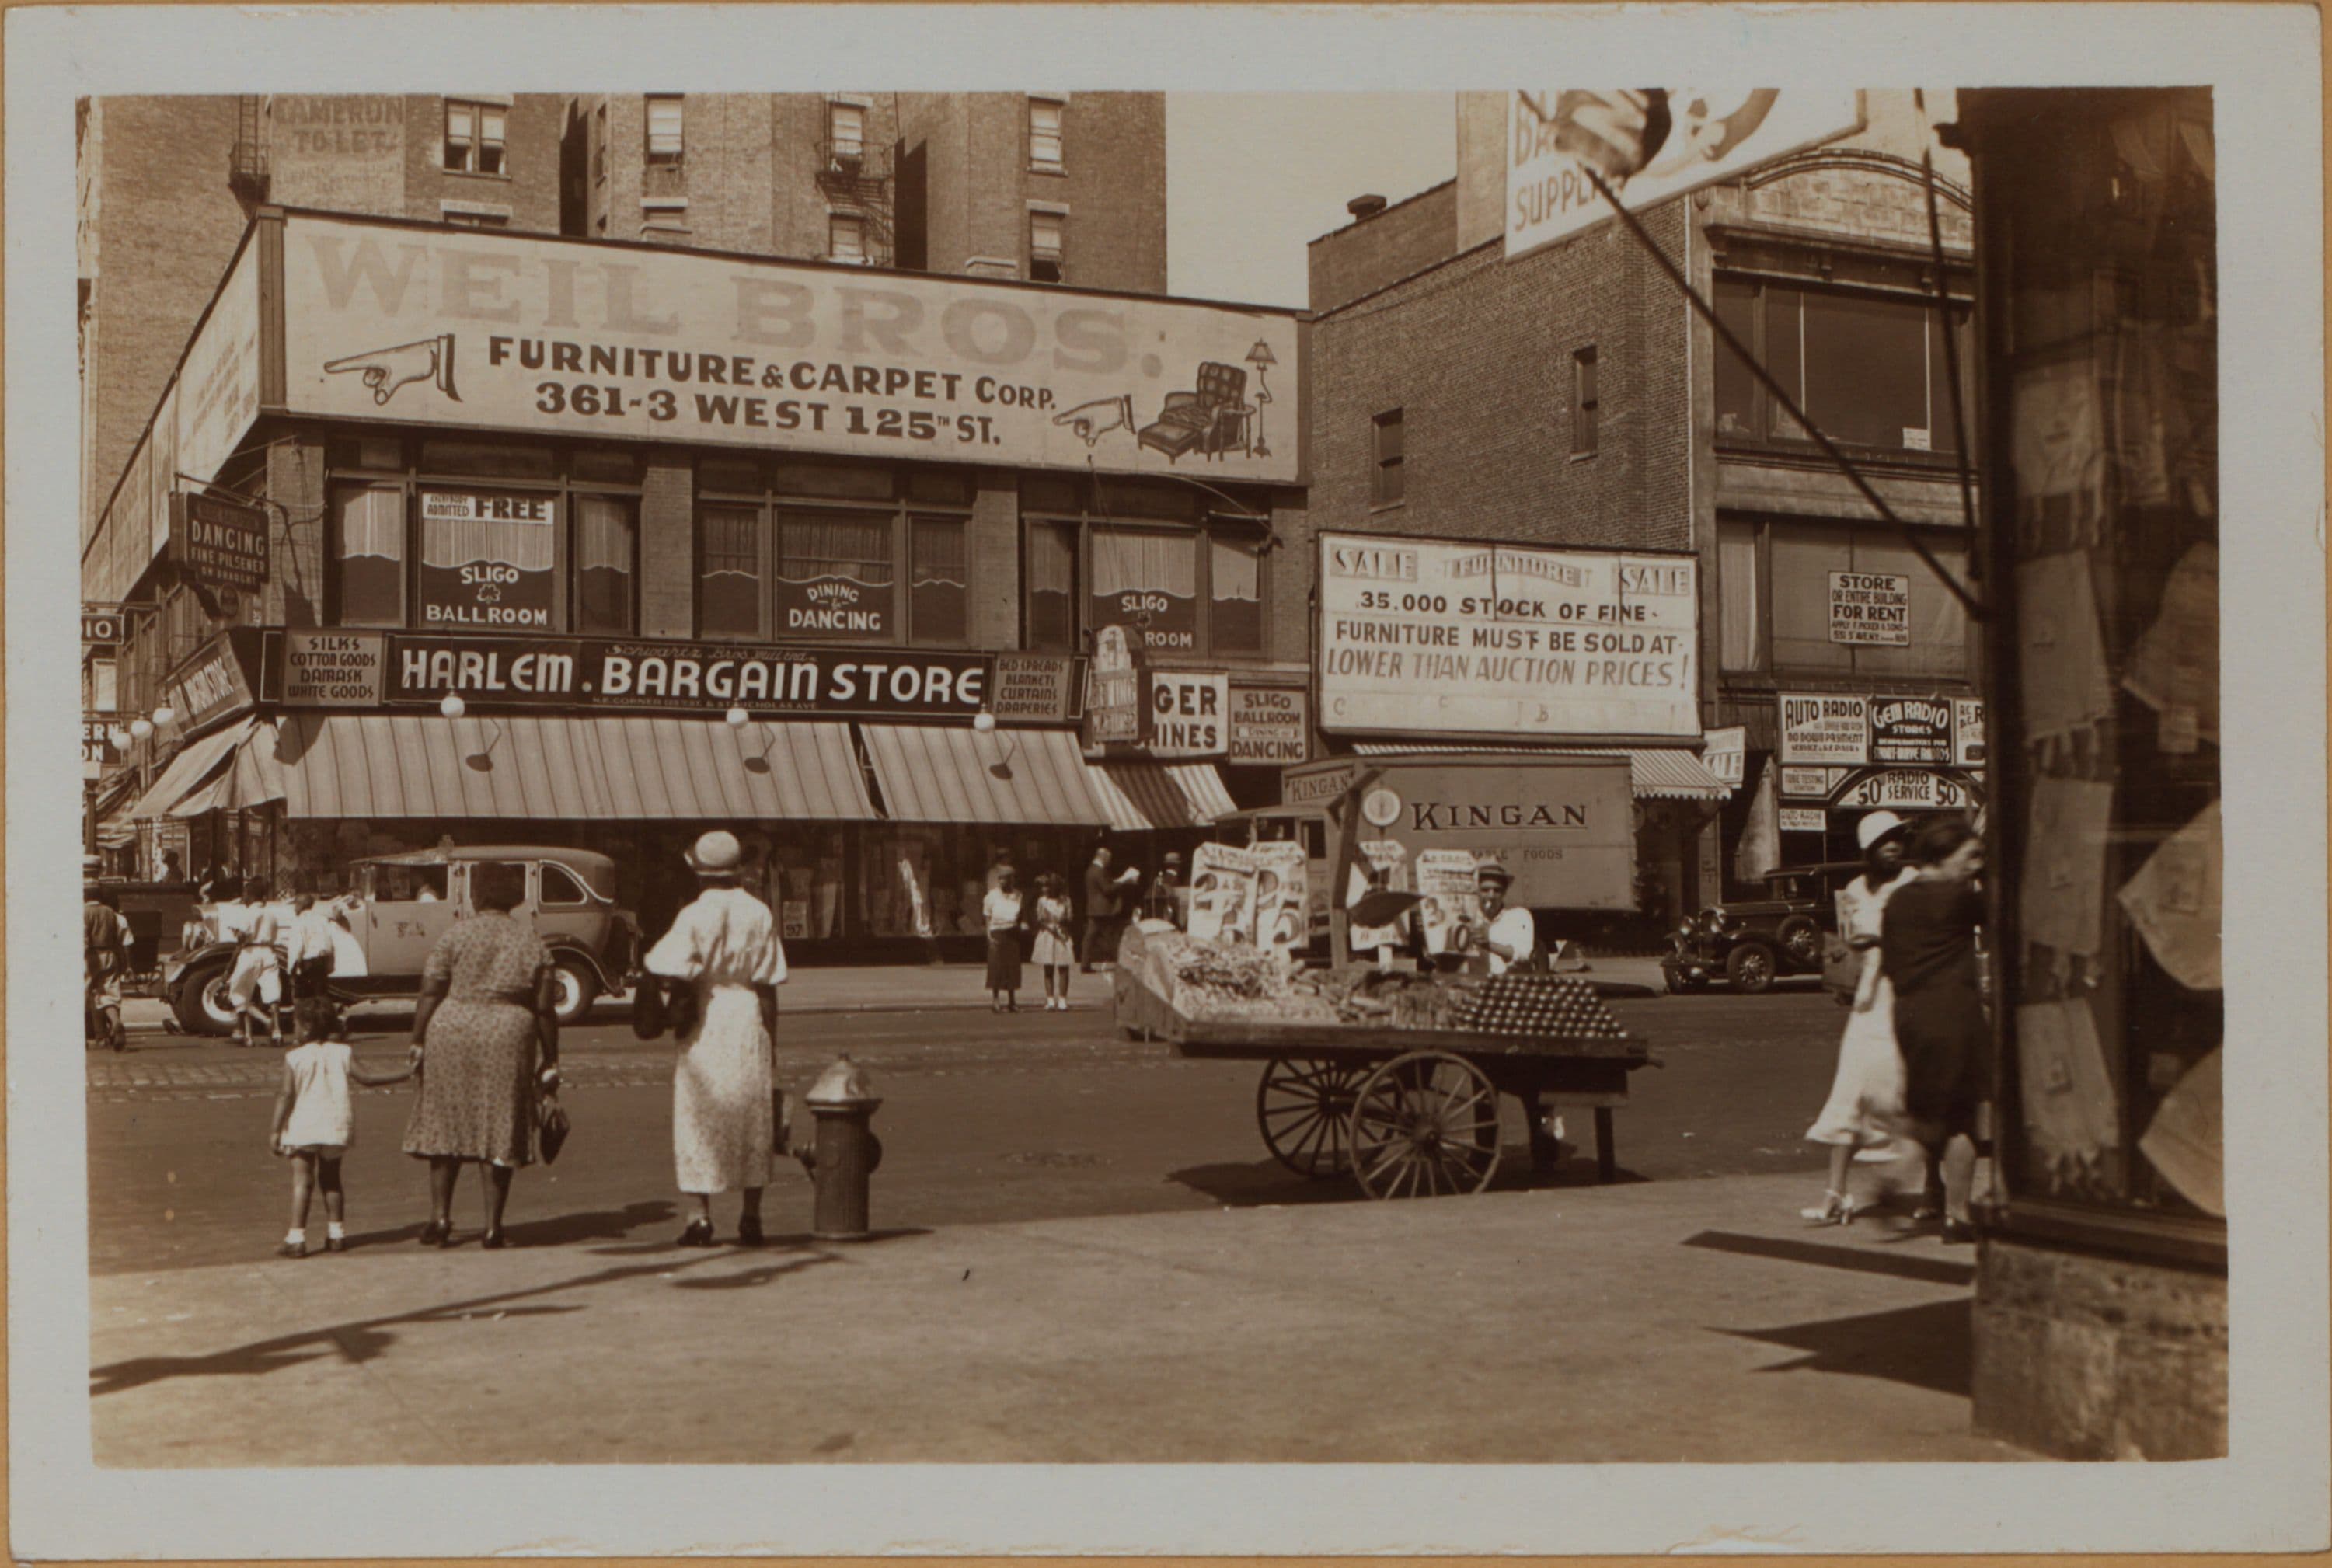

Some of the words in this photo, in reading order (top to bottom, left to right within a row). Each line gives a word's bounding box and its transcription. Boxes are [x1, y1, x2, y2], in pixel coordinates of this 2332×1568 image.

[308, 235, 679, 336] WEIL
[729, 274, 1163, 380] BROS.
[489, 334, 755, 385] FURNITURE
[759, 364, 784, 390] &
[788, 361, 963, 401] CARPET
[536, 381, 677, 421] 361-3
[694, 394, 829, 430] WEST
[845, 406, 950, 441] 125TH
[957, 415, 1002, 446] ST.
[475, 498, 546, 521] FREE
[192, 519, 265, 556] DANCING
[191, 546, 215, 565] FINE
[218, 552, 265, 573] PILSENER
[460, 566, 519, 584] SLIGO
[1334, 549, 1417, 580] SALE
[1455, 552, 1577, 586] FURNITURE
[1620, 566, 1690, 596] SALE
[1839, 574, 1896, 591] STORE
[807, 584, 859, 602] DINING
[1845, 591, 1871, 605] ENTIRE
[1873, 592, 1907, 606] BUILDING
[1121, 594, 1169, 612] SLIGO
[1459, 597, 1546, 618] STOCK
[1559, 603, 1588, 620] OF
[1598, 605, 1646, 622] FINE
[427, 604, 548, 625] BALLROOM
[789, 608, 881, 631] DANCING
[1833, 604, 1863, 620] FOR
[1867, 606, 1906, 622] RENT
[81, 620, 113, 639] IO
[1336, 620, 1459, 647] FURNITURE
[1473, 626, 1539, 651] MUST
[1549, 631, 1577, 652] BE
[1584, 632, 1645, 654] SOLD
[1649, 634, 1678, 655] AT
[309, 637, 361, 650] SILKS
[1145, 631, 1193, 648] ROOM
[290, 653, 337, 667] COTTON
[339, 653, 376, 667] GOODS
[999, 659, 1019, 672] BED
[1020, 659, 1063, 673] SPREADS
[1327, 647, 1403, 679] LOWER
[1412, 653, 1470, 681] THAN
[1475, 655, 1576, 685] AUCTION
[300, 668, 363, 683] DAMASK
[400, 650, 573, 693] HARLEM
[601, 656, 819, 701] BARGAIN
[828, 664, 985, 705] STORE
[1006, 674, 1056, 687] BLANKETS
[288, 685, 326, 699] WHITE
[329, 685, 374, 699] GOODS
[1000, 688, 1058, 700] CURTAINS
[1244, 692, 1291, 709] SLIGO
[995, 701, 1058, 715] DRAPERIES
[1785, 700, 1820, 731] AUTO
[1823, 700, 1863, 717] RADIO
[1873, 702, 1903, 729] GEM
[1903, 701, 1949, 730] RADIO
[1233, 710, 1301, 725] BALLROOM
[1891, 724, 1933, 734] STORES
[1231, 740, 1304, 759] DANCING
[1886, 771, 1930, 785] RADIO
[1292, 774, 1350, 803] KINGAN
[1857, 778, 1881, 806] 50
[1888, 785, 1930, 800] SERVICE
[1936, 777, 1957, 806] 50
[1410, 802, 1587, 831] KINGAN
[1523, 848, 1563, 860] FOODS
